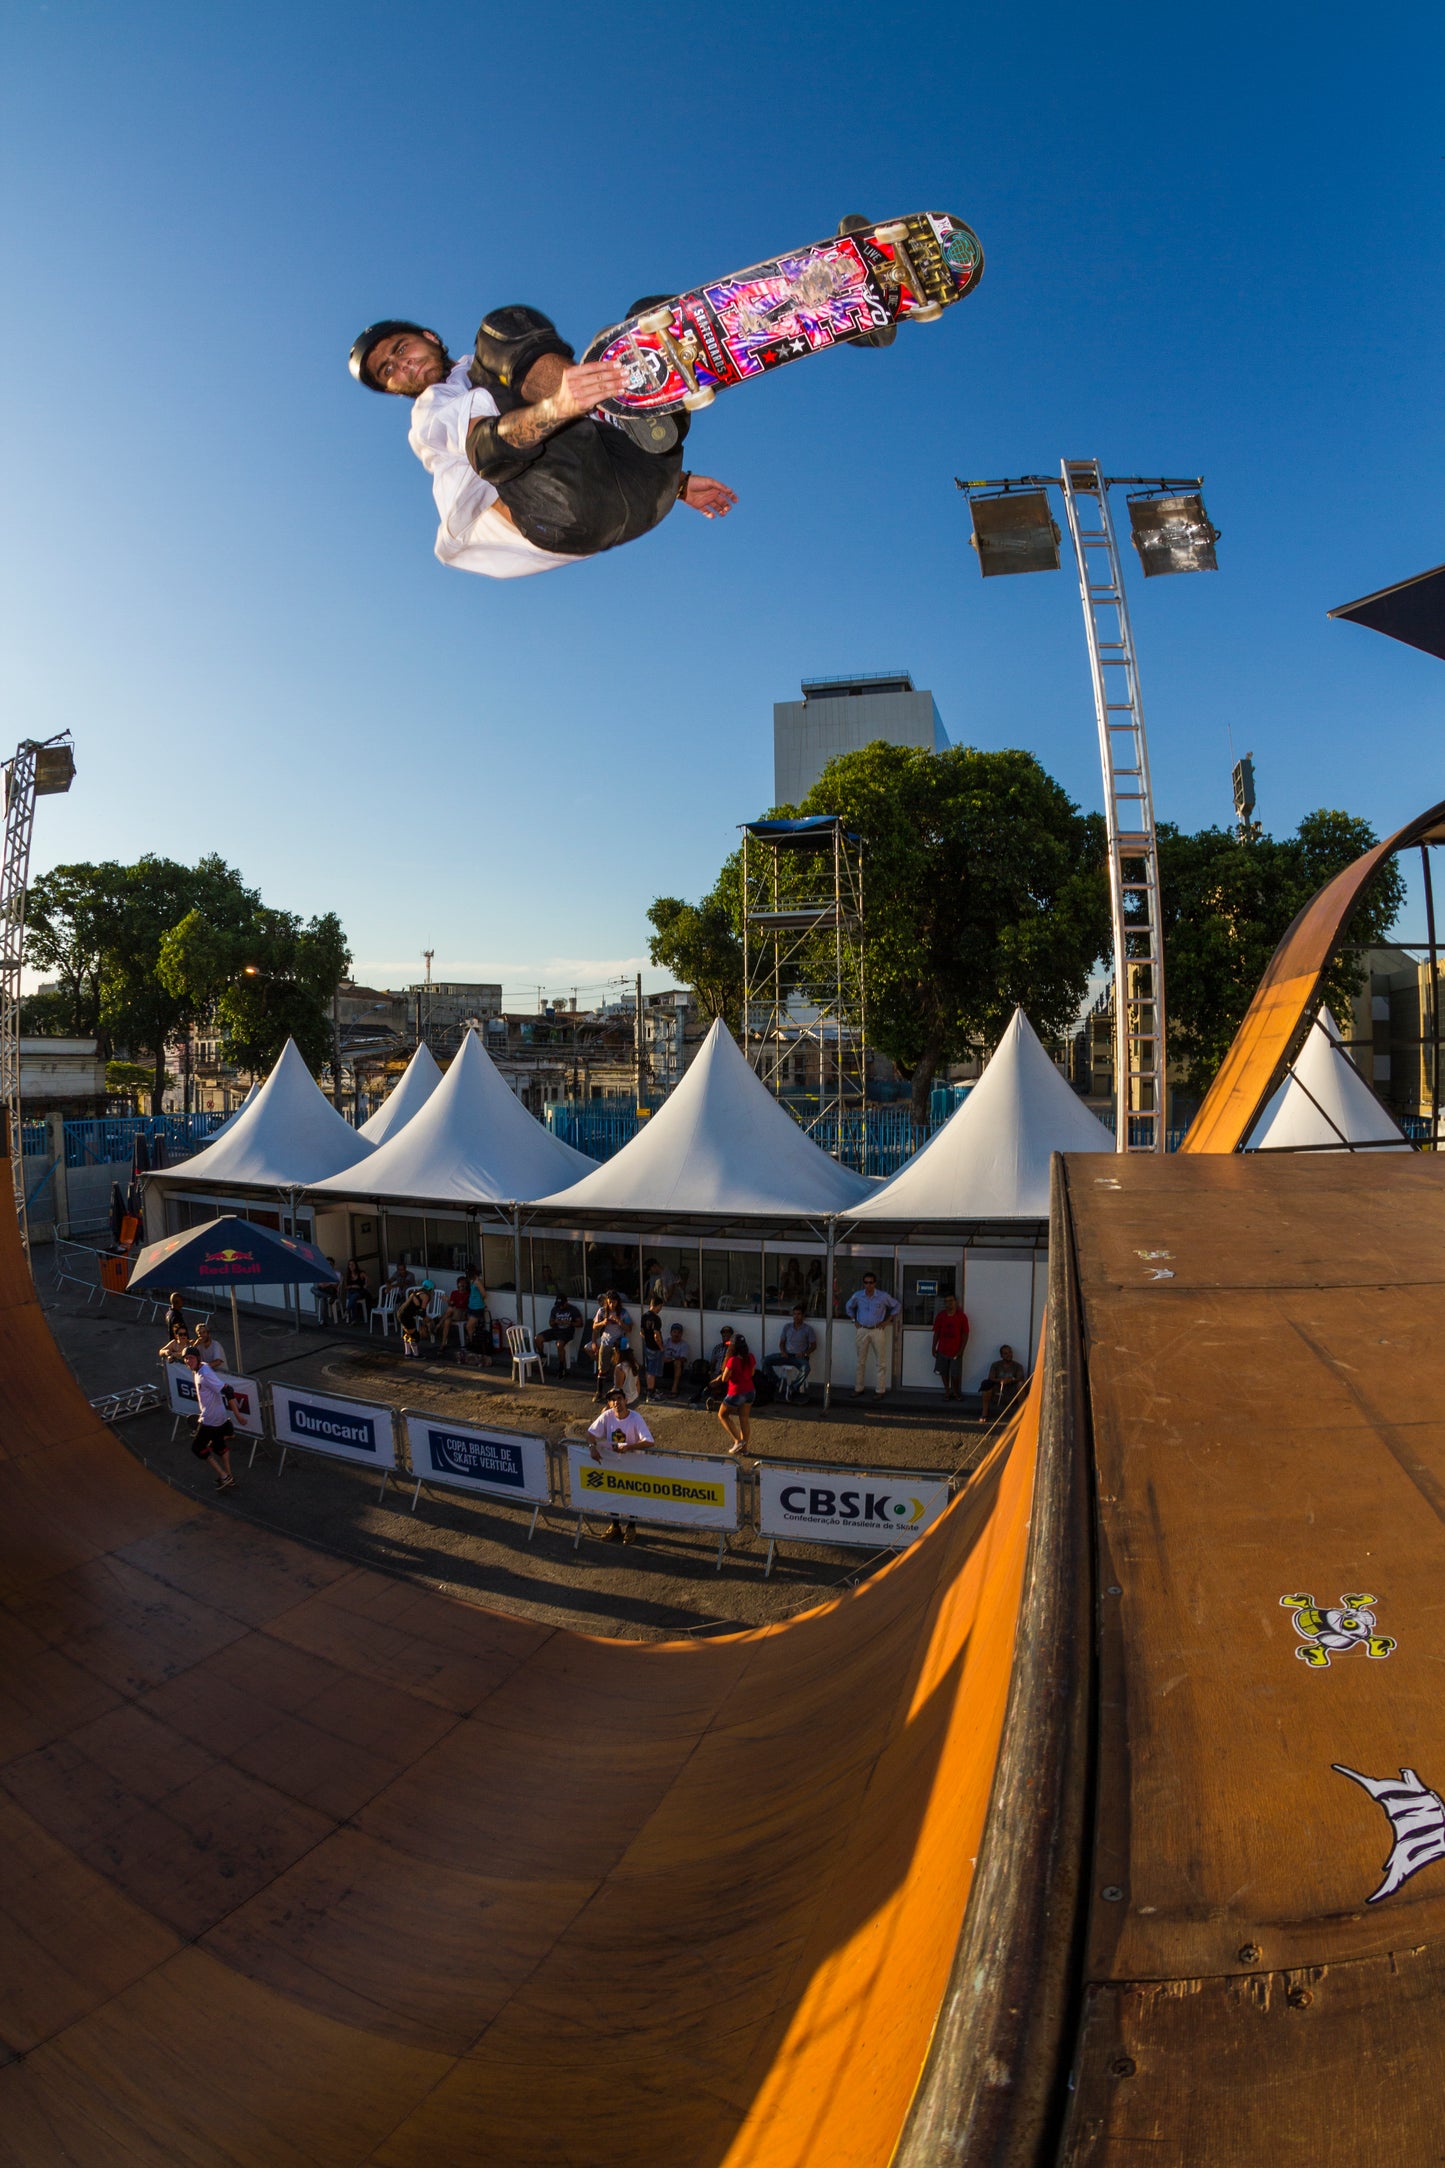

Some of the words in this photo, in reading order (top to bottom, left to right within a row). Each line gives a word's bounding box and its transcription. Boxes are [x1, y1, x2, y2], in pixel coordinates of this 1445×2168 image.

[863, 244, 882, 261] LIVE
[692, 307, 728, 376] SKATEBOARDS
[199, 1264, 229, 1275] Red
[231, 1263, 261, 1274] Bull
[295, 1409, 369, 1443] Ourocard
[446, 1438, 467, 1453] COPA
[469, 1442, 498, 1459] BRASIL
[500, 1448, 512, 1461] DE
[453, 1452, 478, 1467] SKATE
[480, 1456, 518, 1474] VERTICAL
[607, 1475, 651, 1493] BANCO
[653, 1483, 670, 1495] DO
[671, 1484, 718, 1501] BRASIL
[779, 1485, 893, 1522] CBSK
[783, 1512, 840, 1526] Confederação
[842, 1518, 881, 1529] Brasileira
[883, 1522, 894, 1530] de
[896, 1523, 919, 1531] Skate
